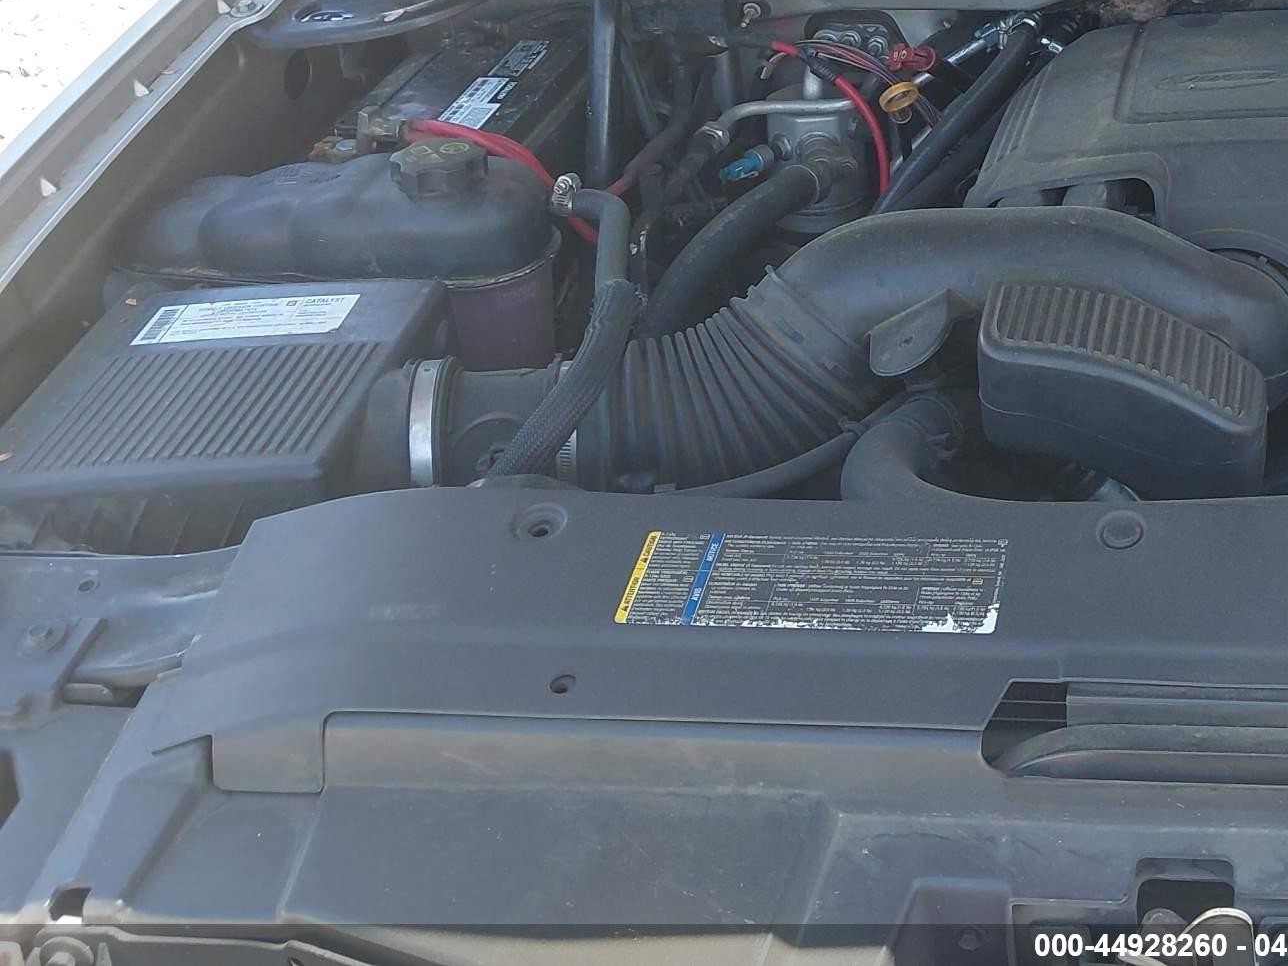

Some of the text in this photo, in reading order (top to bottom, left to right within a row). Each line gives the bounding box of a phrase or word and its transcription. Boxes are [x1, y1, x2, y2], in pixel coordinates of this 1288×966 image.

[706, 542, 720, 562] NOTICE
[625, 577, 640, 604] ATTENTION
[691, 587, 702, 601] AVIS
